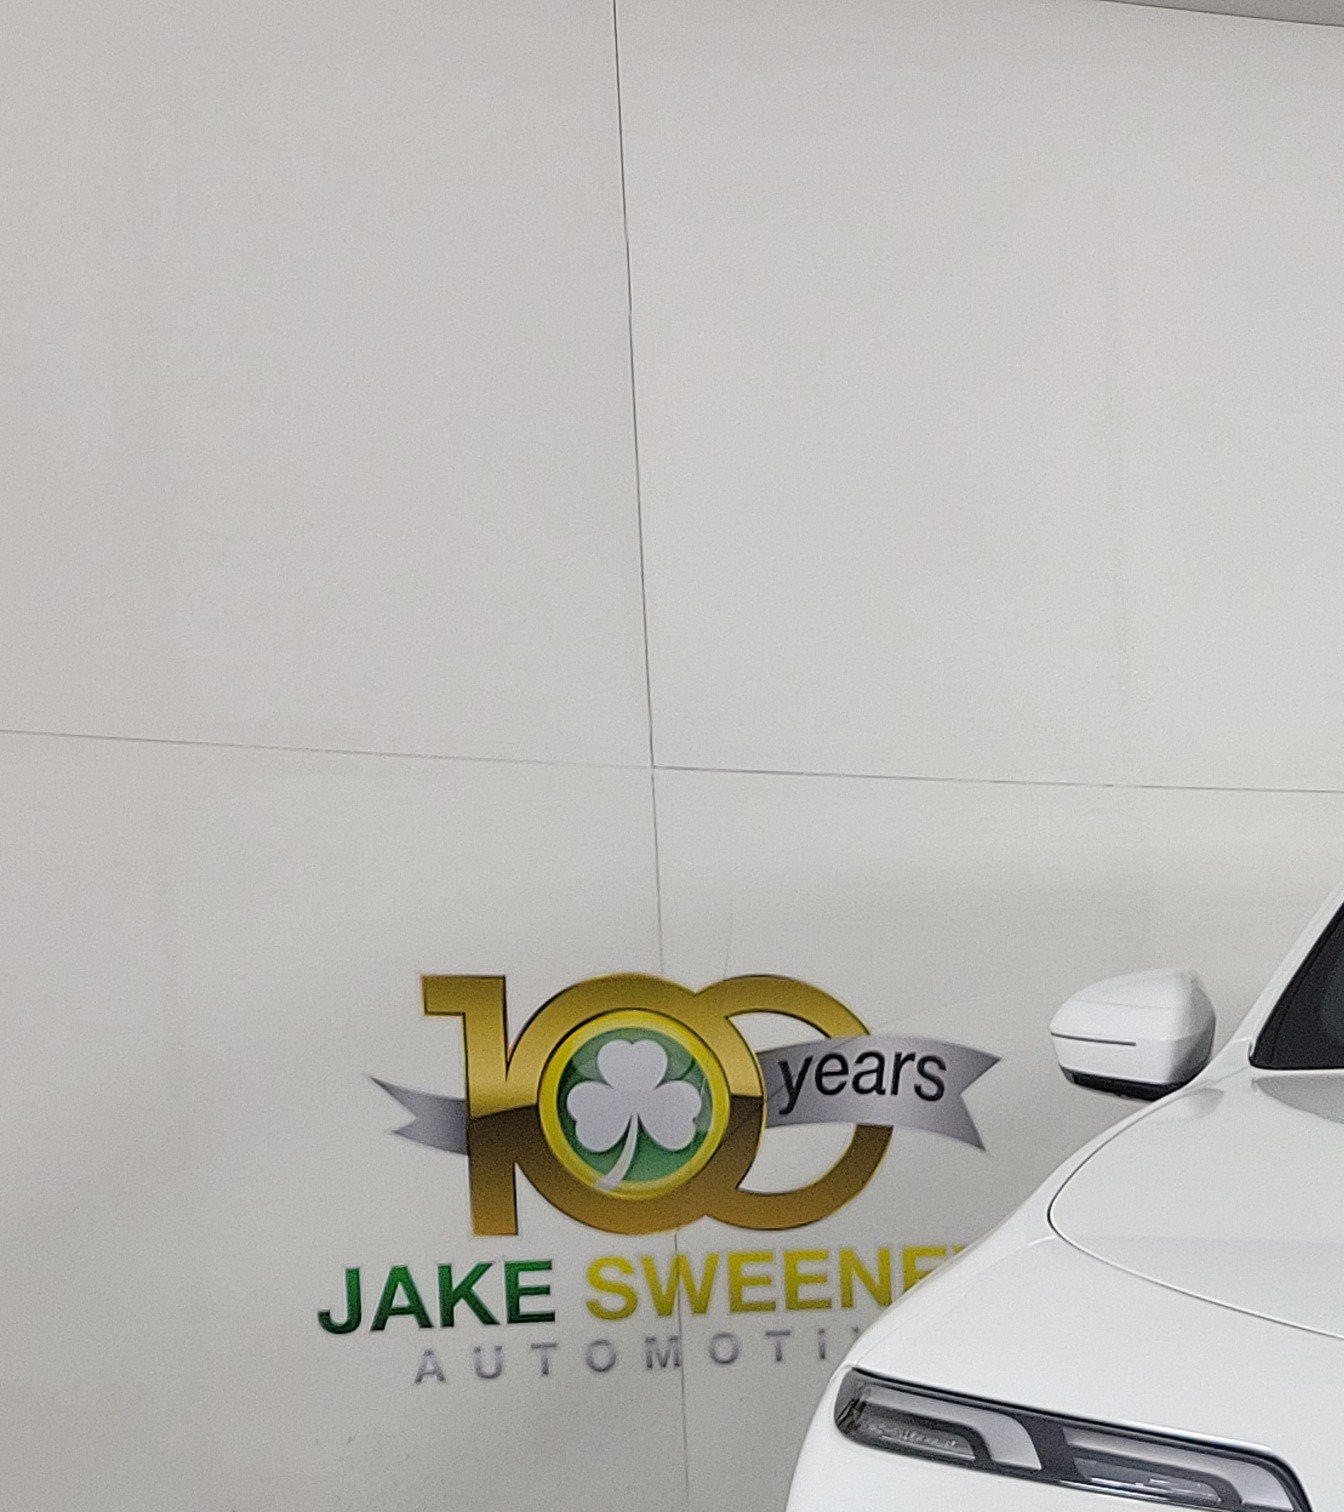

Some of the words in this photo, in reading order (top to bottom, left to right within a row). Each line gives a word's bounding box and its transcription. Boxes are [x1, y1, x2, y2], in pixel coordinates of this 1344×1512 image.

[420, 972, 894, 1237] 100
[777, 1049, 949, 1114] years
[317, 1259, 557, 1335] JAKE
[584, 1244, 967, 1321] SWEENE
[413, 1326, 859, 1386] AUTOMOTI
